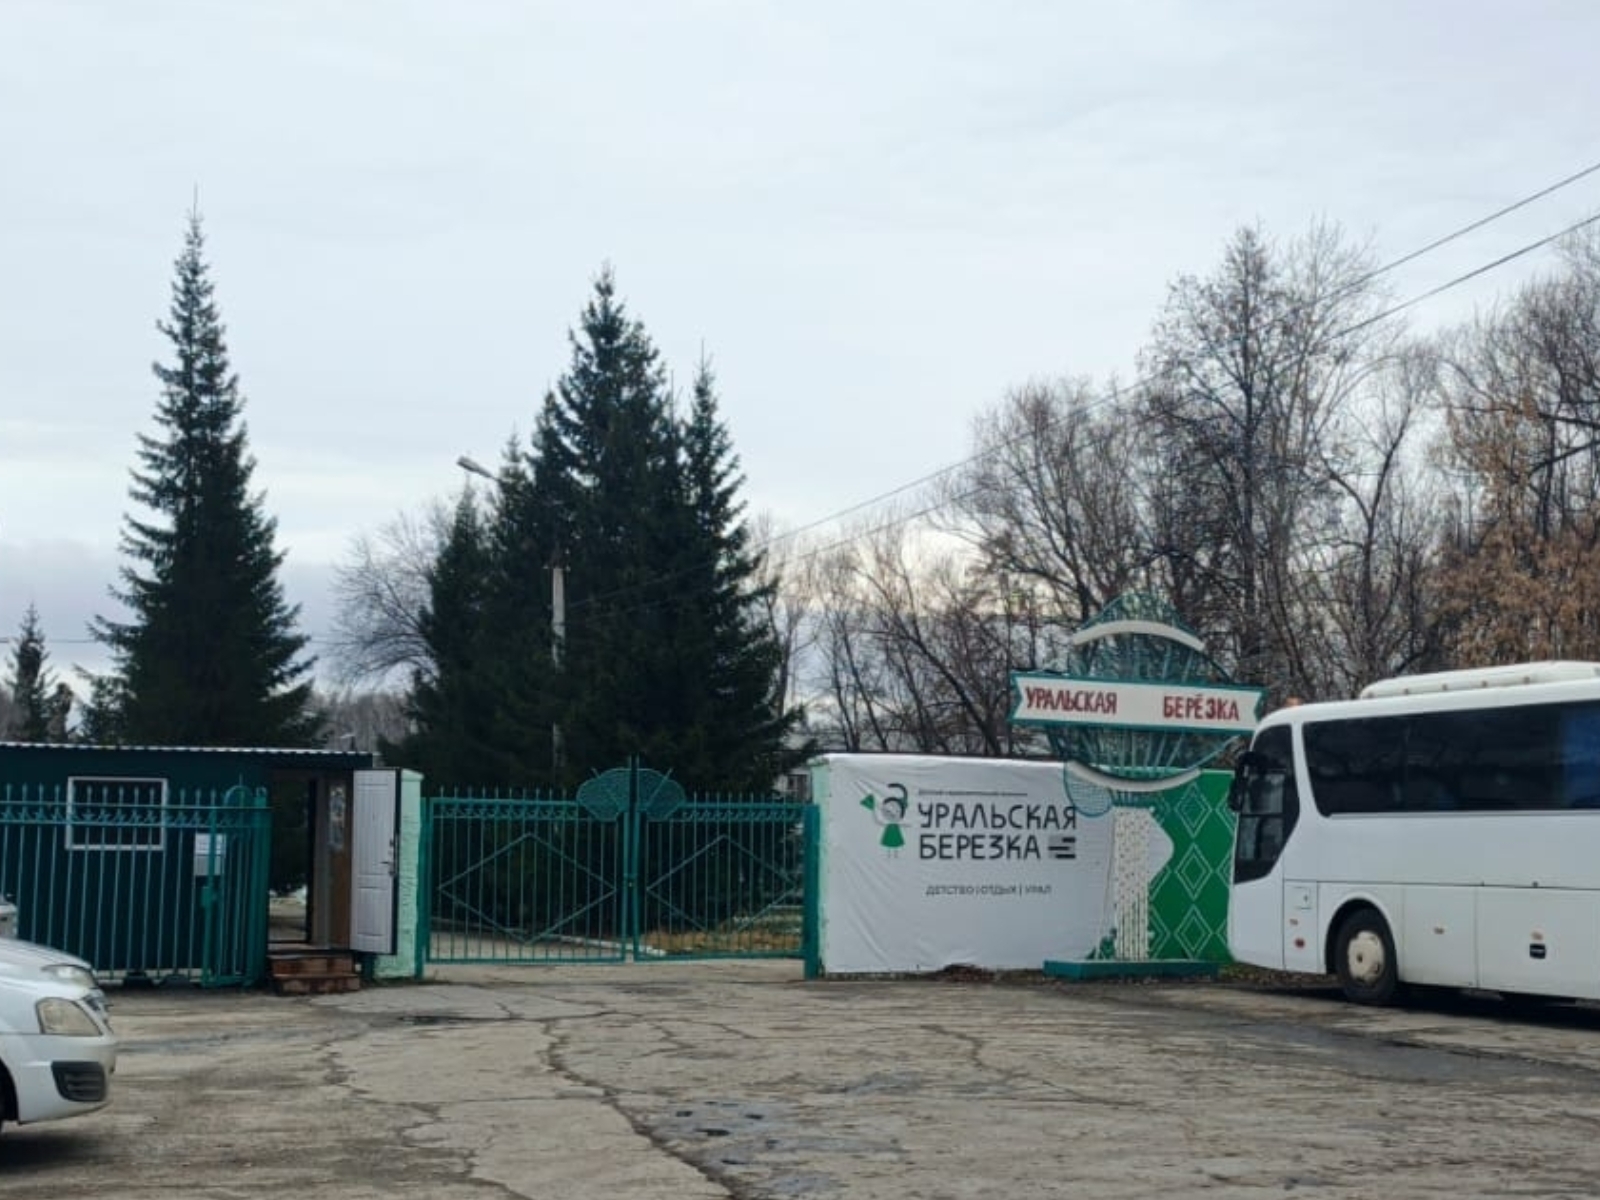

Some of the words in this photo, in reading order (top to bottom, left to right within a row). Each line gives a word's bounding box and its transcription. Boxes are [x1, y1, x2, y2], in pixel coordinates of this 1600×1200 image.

[1025, 687, 1118, 714] УРАЛЬСКАЯ
[1163, 693, 1240, 721] БЕРЁЗКА
[918, 802, 1077, 830] УРАЛЬСКАЯ
[919, 834, 1042, 860] БЕРЕЗКА
